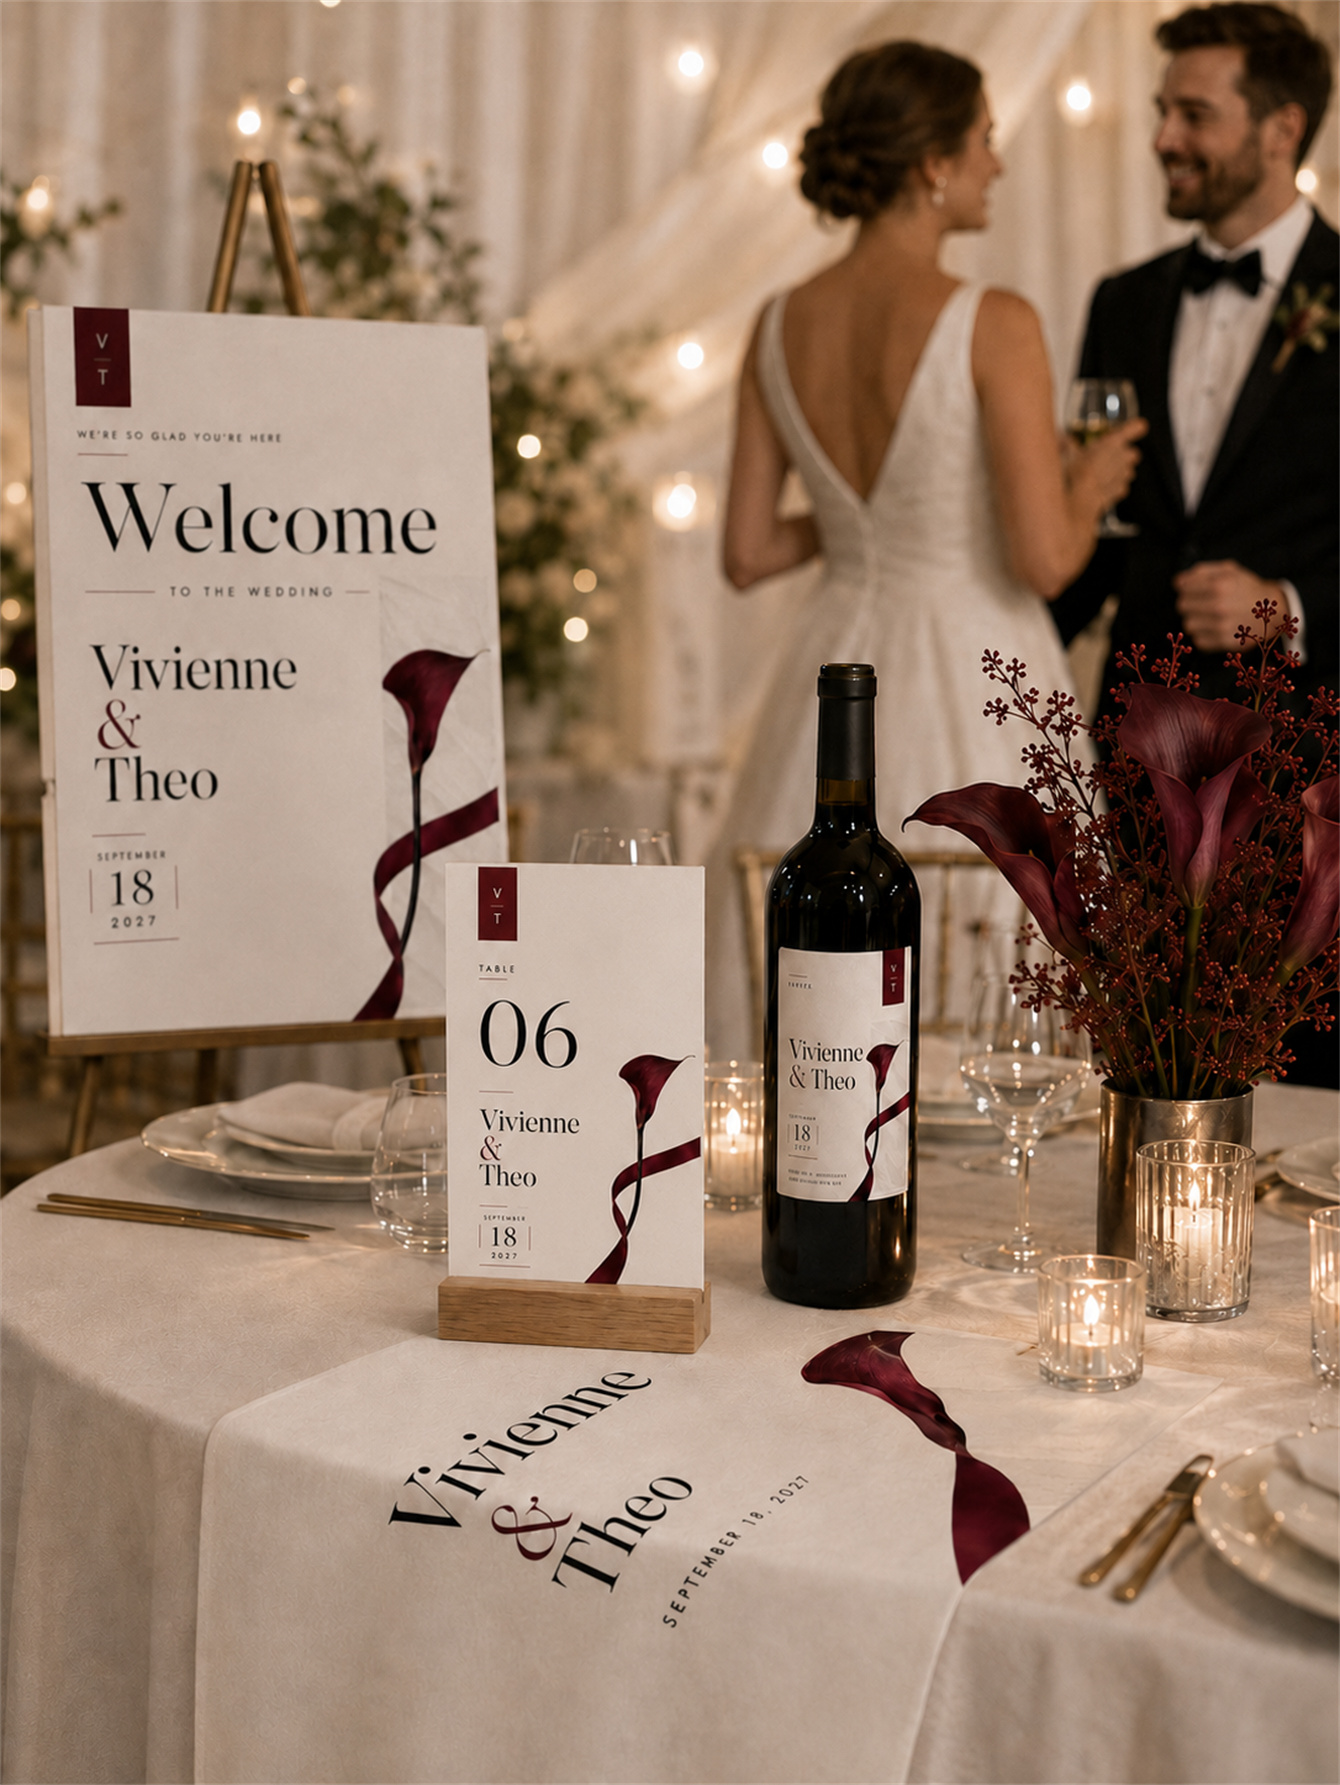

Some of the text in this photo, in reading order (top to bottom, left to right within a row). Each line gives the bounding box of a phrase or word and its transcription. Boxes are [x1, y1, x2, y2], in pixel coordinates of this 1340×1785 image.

[95, 333, 109, 349] V
[97, 368, 109, 386] T
[76, 429, 281, 443] WE'RE SO GLAD YOU'RE HERE
[81, 481, 437, 555] Welcome
[169, 585, 333, 598] TO THE WEDDING
[90, 644, 297, 691] Vivienne
[97, 699, 141, 751] &
[94, 755, 219, 802] Theo
[97, 850, 166, 862] SEPTEMBER
[112, 869, 154, 906] 18
[492, 887, 502, 899] V
[111, 914, 156, 929] 2027
[493, 912, 502, 925] T
[478, 963, 515, 974] TABLE
[890, 964, 897, 973] V
[890, 982, 897, 992] T
[479, 999, 578, 1069] 06
[788, 1037, 864, 1063] Vivienne
[789, 1064, 856, 1091] & Theo
[480, 1108, 580, 1134] Vivienne
[794, 1123, 811, 1142] 18
[479, 1135, 502, 1162] &
[479, 1163, 537, 1187] Theo
[483, 1214, 526, 1222] SEPTEMBER
[492, 1226, 517, 1247] 18
[491, 1251, 518, 1260] 2027
[388, 1370, 653, 1529] Vivienne
[491, 1496, 574, 1562] &
[551, 1475, 694, 1594] Theo
[662, 1531, 741, 1629] SEPTEMBER
[769, 1475, 809, 1505] 2027
